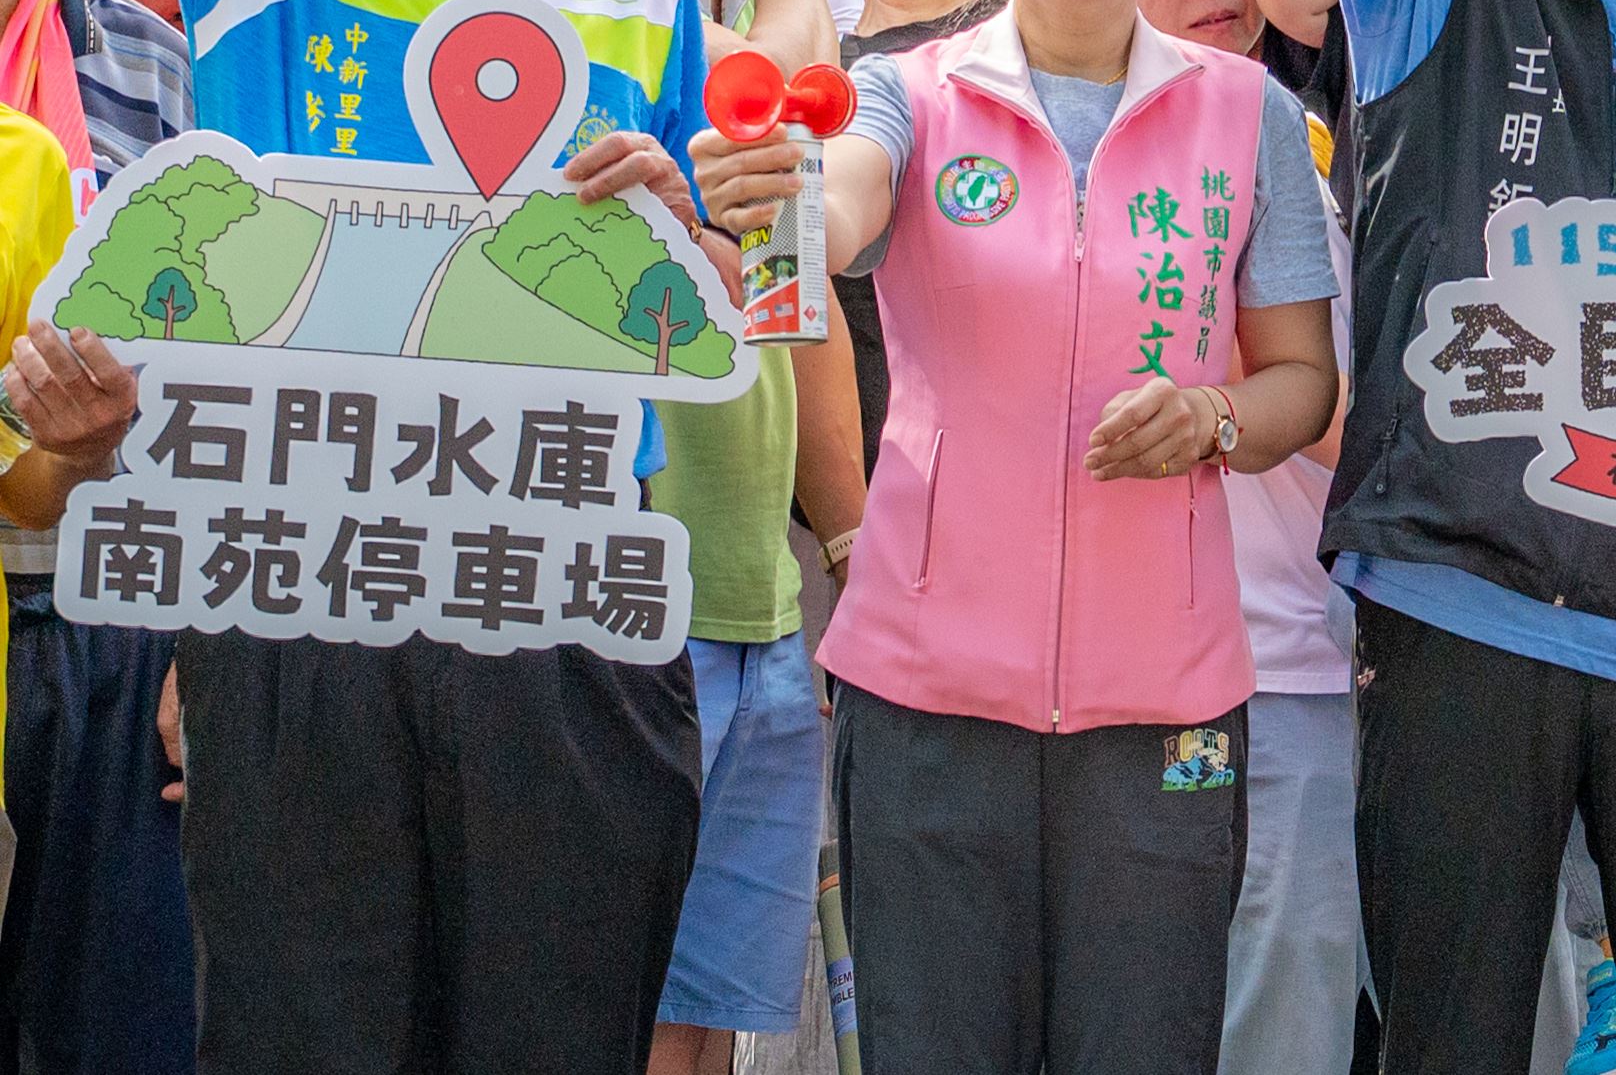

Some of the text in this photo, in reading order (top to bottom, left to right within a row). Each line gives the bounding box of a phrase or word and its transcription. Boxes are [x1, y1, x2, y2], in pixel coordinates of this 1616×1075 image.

[329, 21, 370, 156] 中新里里
[1127, 186, 1196, 383] 陳治文
[1194, 165, 1236, 366] 桃園市議員
[146, 382, 620, 510] 石門水庫
[79, 497, 669, 641] 南苑停車場
[1164, 728, 1229, 768] ROOTS
